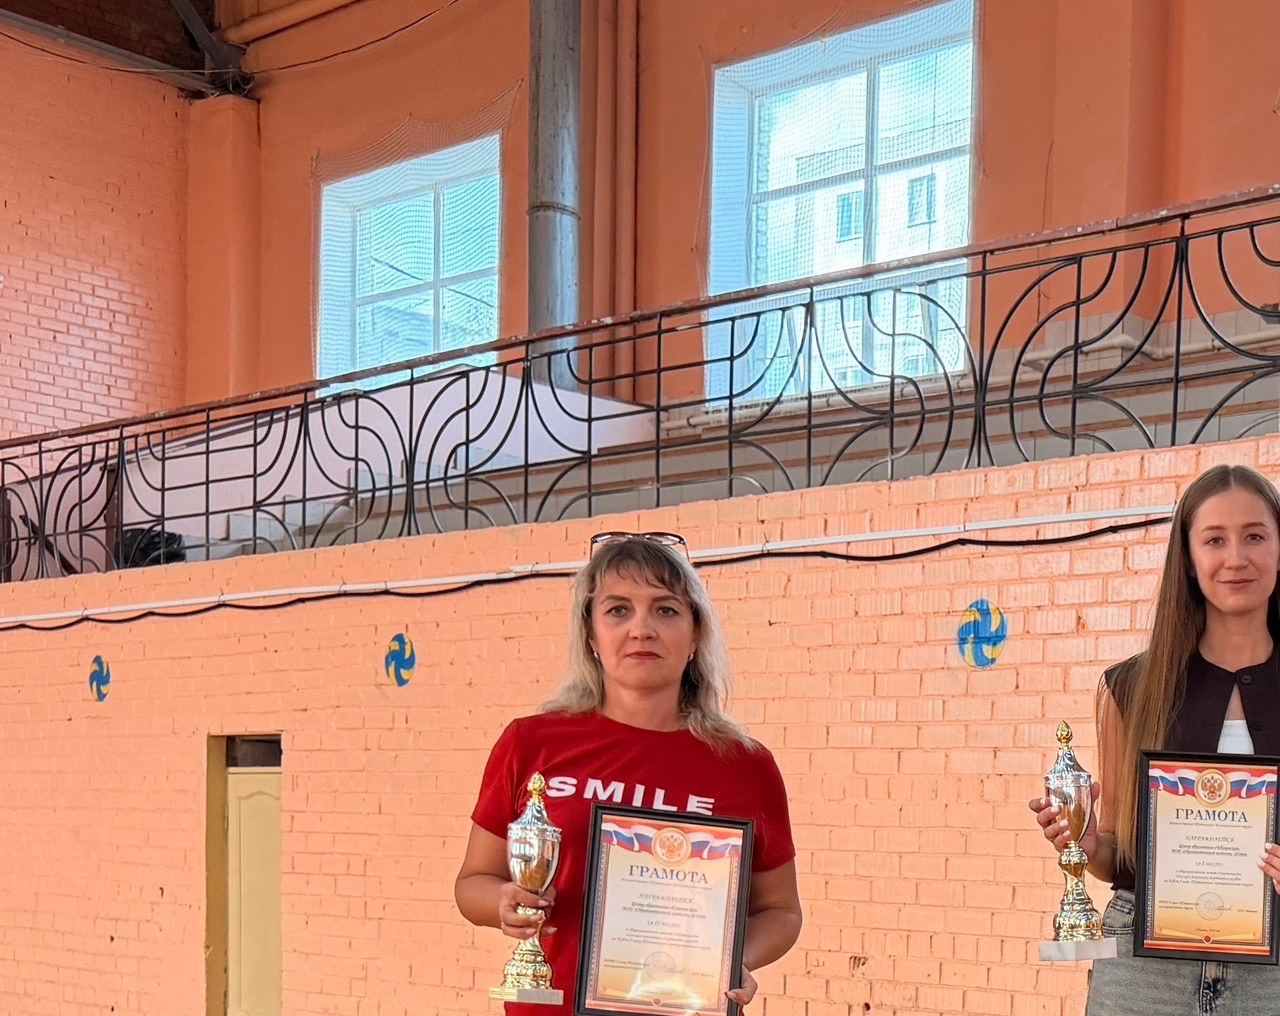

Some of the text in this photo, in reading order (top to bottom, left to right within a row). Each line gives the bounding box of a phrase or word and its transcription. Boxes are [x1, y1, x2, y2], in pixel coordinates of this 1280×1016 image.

[546, 776, 715, 815] SMILE
[1175, 808, 1248, 822] ГРАМОТА
[629, 864, 709, 884] ГРАМОТА
